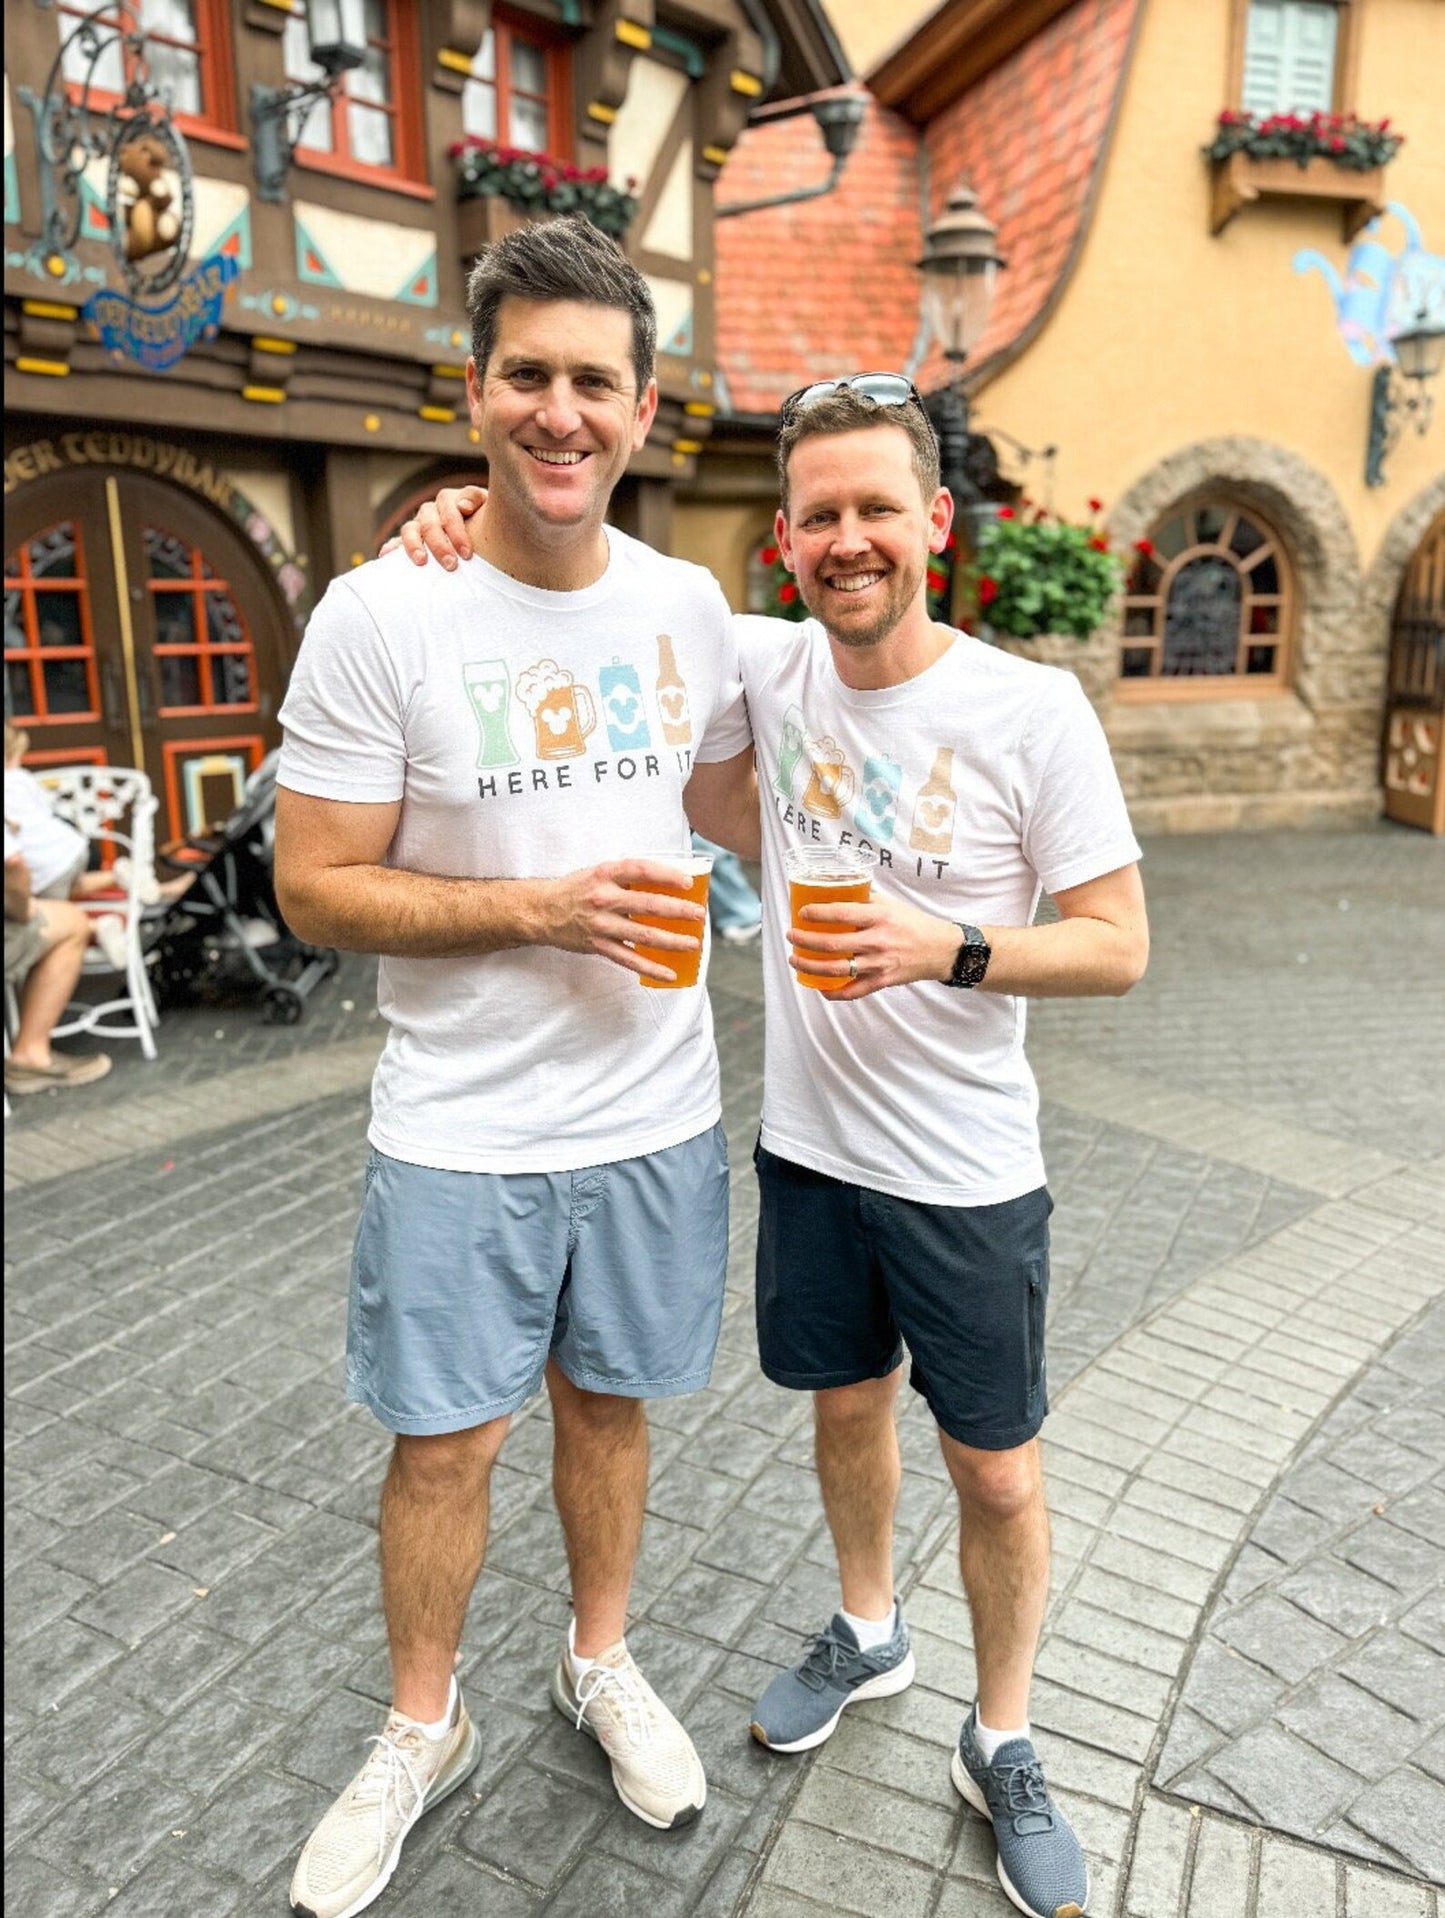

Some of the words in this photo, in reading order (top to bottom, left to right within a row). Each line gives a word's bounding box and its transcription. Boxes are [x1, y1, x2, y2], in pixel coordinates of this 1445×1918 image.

[478, 765, 572, 799] HERE
[594, 755, 660, 783] FOR
[676, 750, 691, 773] IT
[775, 797, 821, 841] ERE
[916, 857, 949, 880] IT
